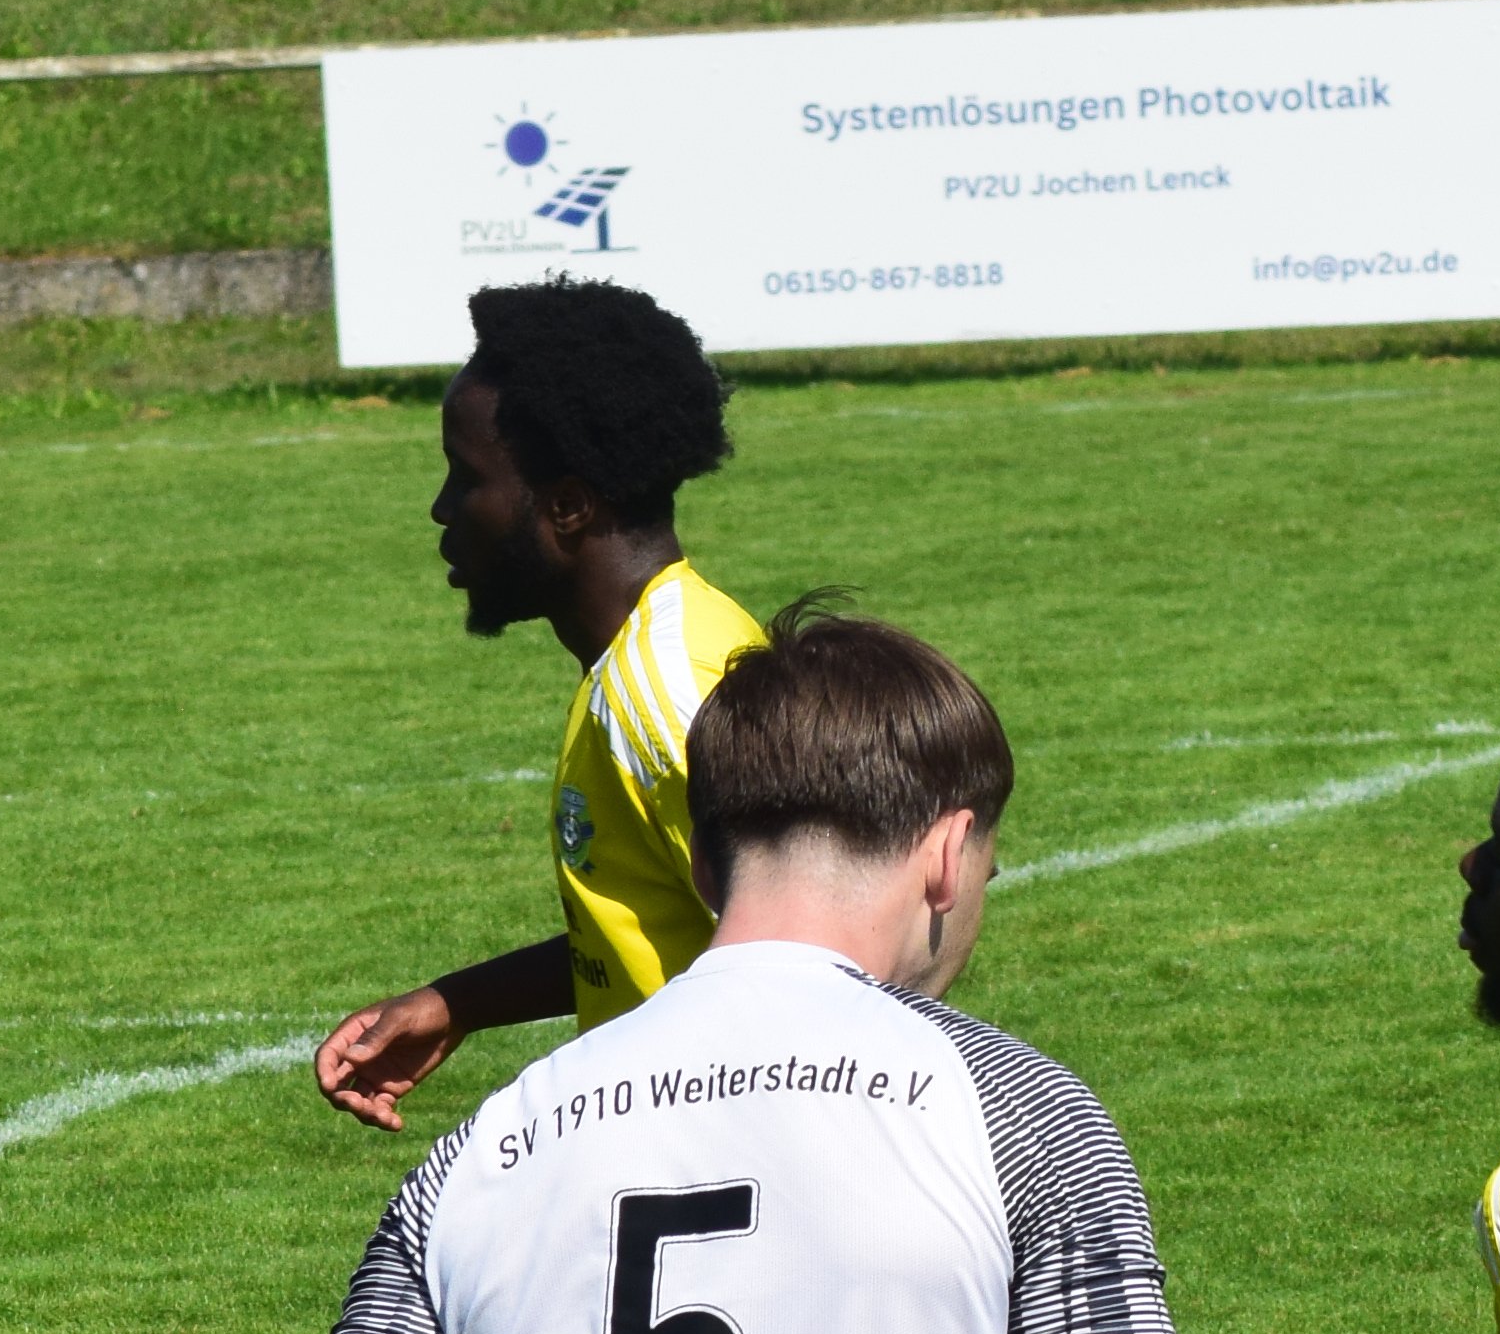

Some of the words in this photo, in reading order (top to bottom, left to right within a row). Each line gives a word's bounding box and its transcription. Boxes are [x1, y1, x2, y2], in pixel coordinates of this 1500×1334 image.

[802, 95, 1125, 142] Systemlösungen
[1138, 75, 1391, 118] Photovoltaik
[945, 175, 1021, 200] PV2U
[1032, 170, 1136, 197] Jochen
[1146, 165, 1231, 192] Lenck
[763, 262, 1004, 295] 06150-867-8818
[1252, 249, 1459, 283] info@pv2u.de
[498, 1117, 538, 1170] SV
[551, 1079, 633, 1140] 1910
[650, 1054, 858, 1109] Weiterstadt
